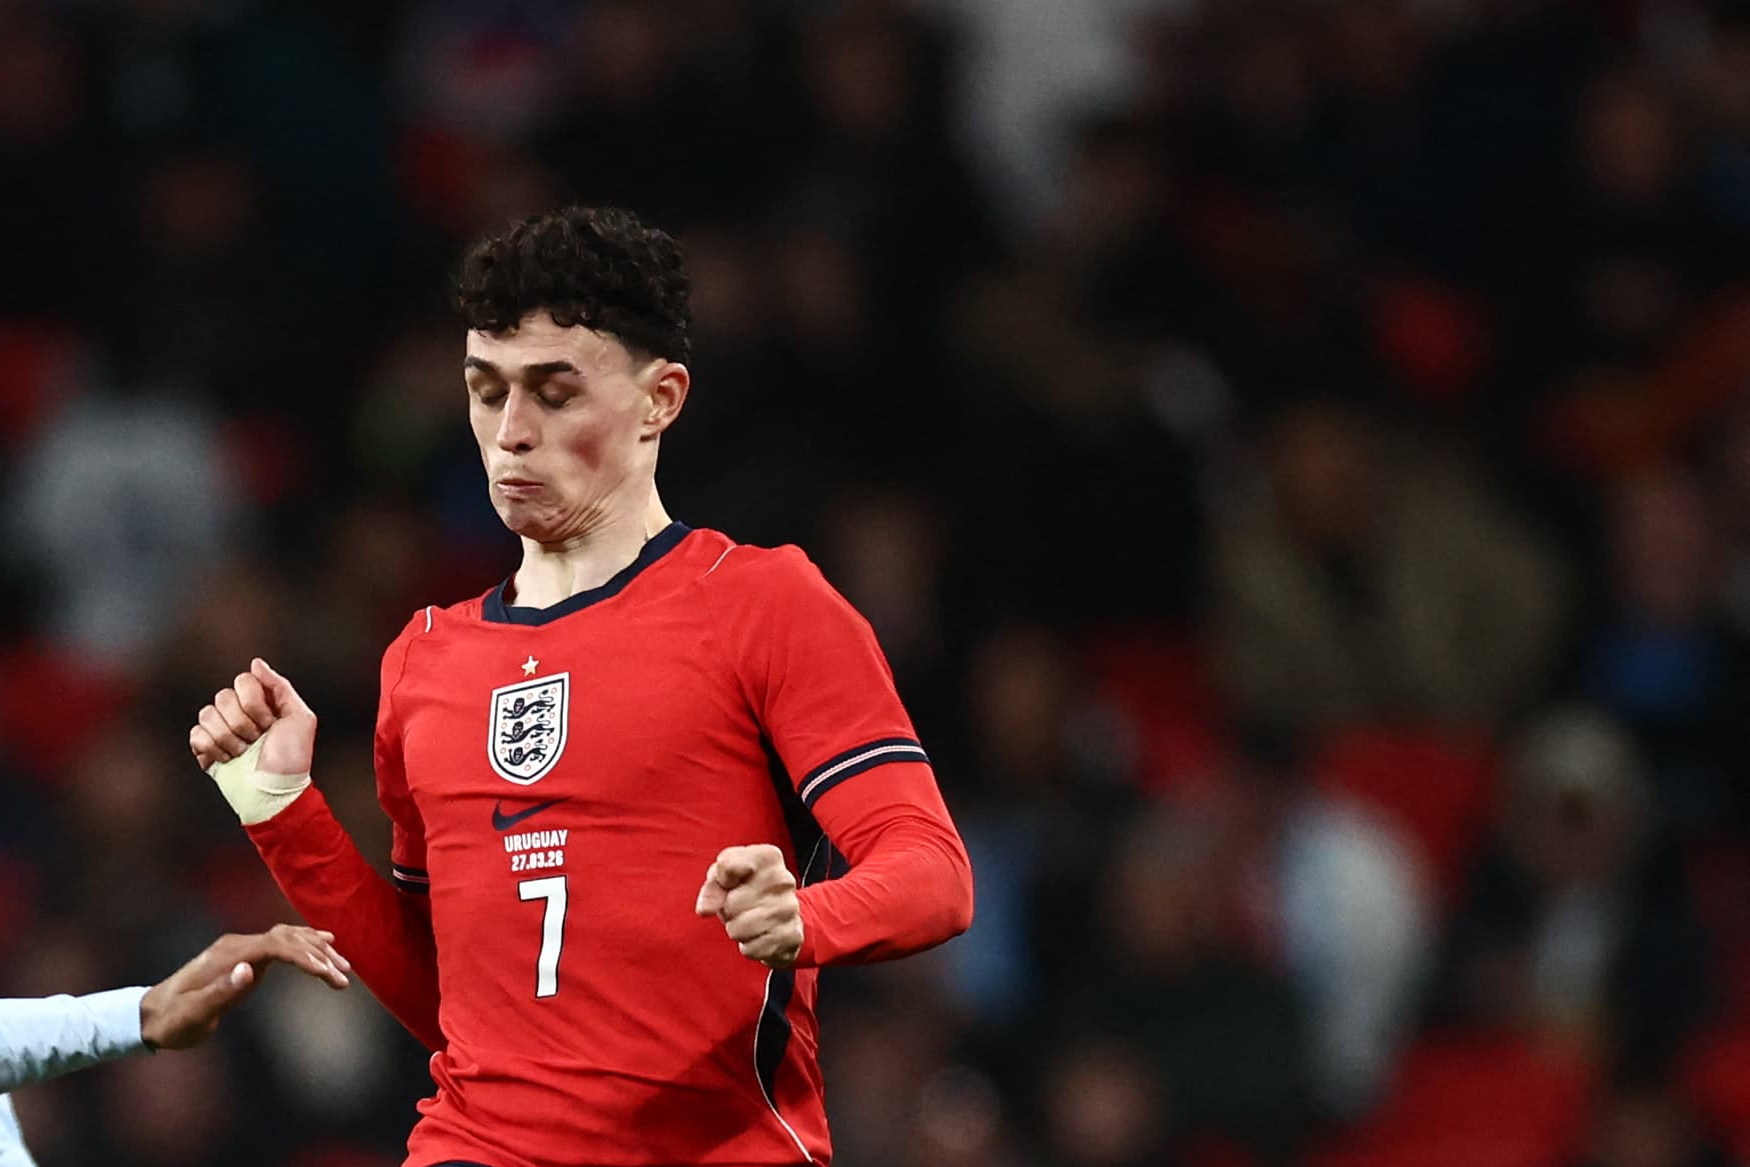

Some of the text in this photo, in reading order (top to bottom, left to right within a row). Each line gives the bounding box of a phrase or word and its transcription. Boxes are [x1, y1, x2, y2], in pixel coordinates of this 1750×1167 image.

[504, 829, 568, 853] URUGUAY
[511, 849, 564, 872] 27.03.26
[518, 875, 568, 998] 7
